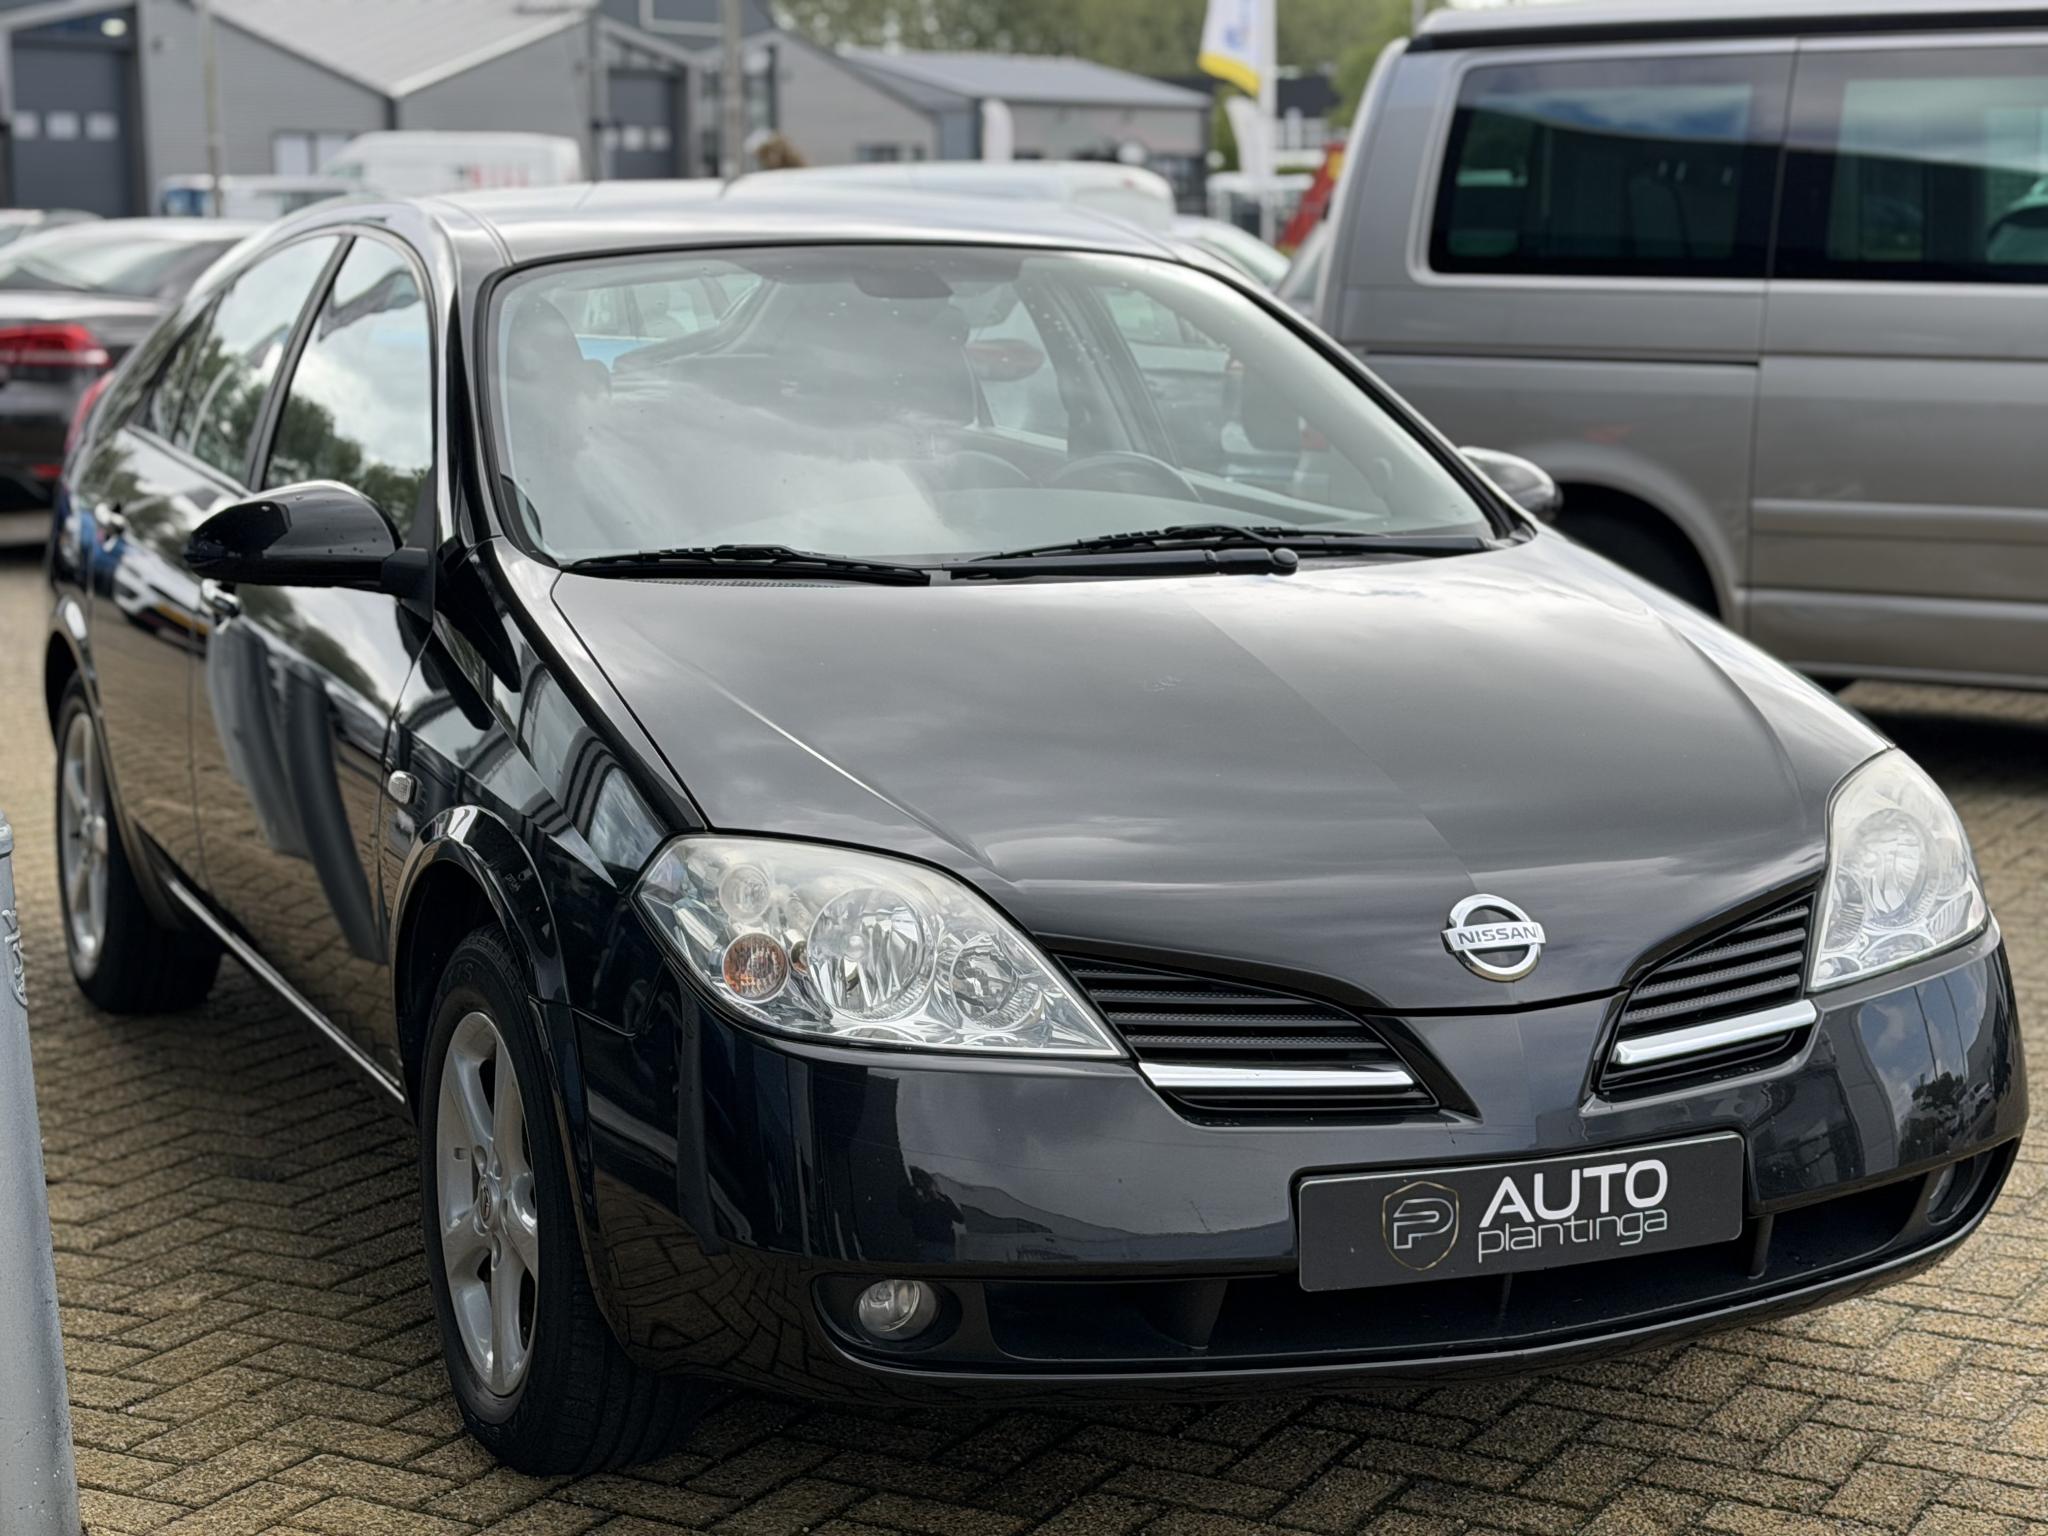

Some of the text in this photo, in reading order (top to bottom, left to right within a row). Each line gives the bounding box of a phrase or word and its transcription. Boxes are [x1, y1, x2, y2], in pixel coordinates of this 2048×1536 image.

[1457, 925, 1538, 945] NISSAN
[1478, 1158, 1669, 1229] AUTO
[1477, 1208, 1668, 1264] plantinga
